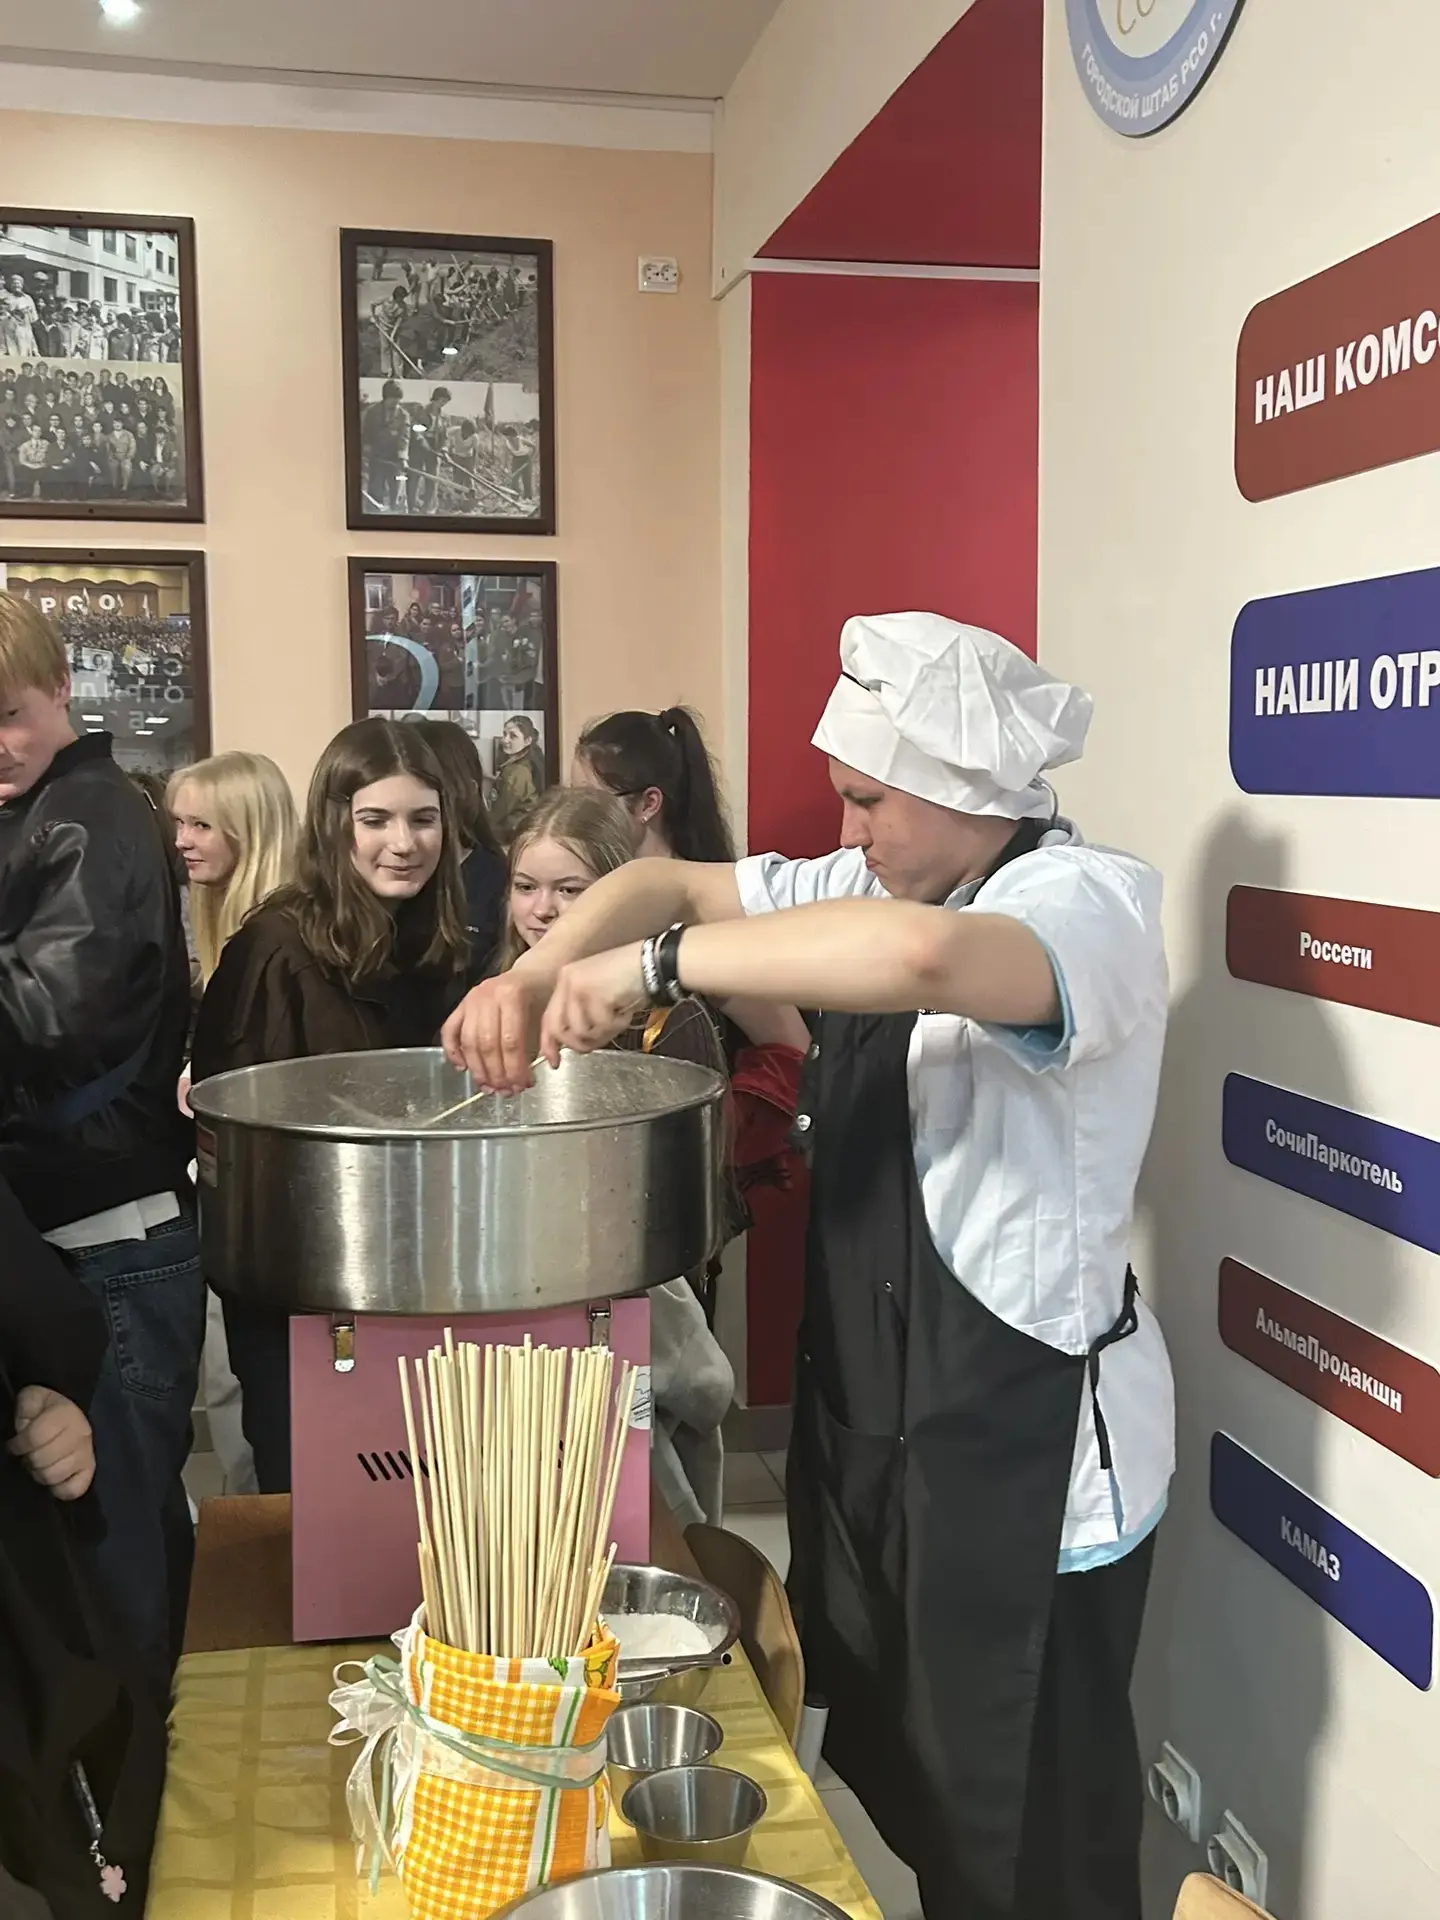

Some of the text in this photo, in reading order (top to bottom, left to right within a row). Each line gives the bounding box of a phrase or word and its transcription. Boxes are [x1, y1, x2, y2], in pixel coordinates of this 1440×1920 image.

[1081, 43, 1140, 119] ГОРОДСКОЙ
[1141, 74, 1179, 118] ШТАБ
[1181, 31, 1208, 85] РСО
[1255, 309, 1440, 425] НАШ КОМС
[1255, 650, 1440, 716] НАШИ ОТР
[1300, 931, 1372, 970] Россети
[1265, 1118, 1403, 1194] СочиПаркотель
[1255, 1307, 1403, 1414] АльмаПродакшн
[1281, 1515, 1341, 1582] КАМАЗ
